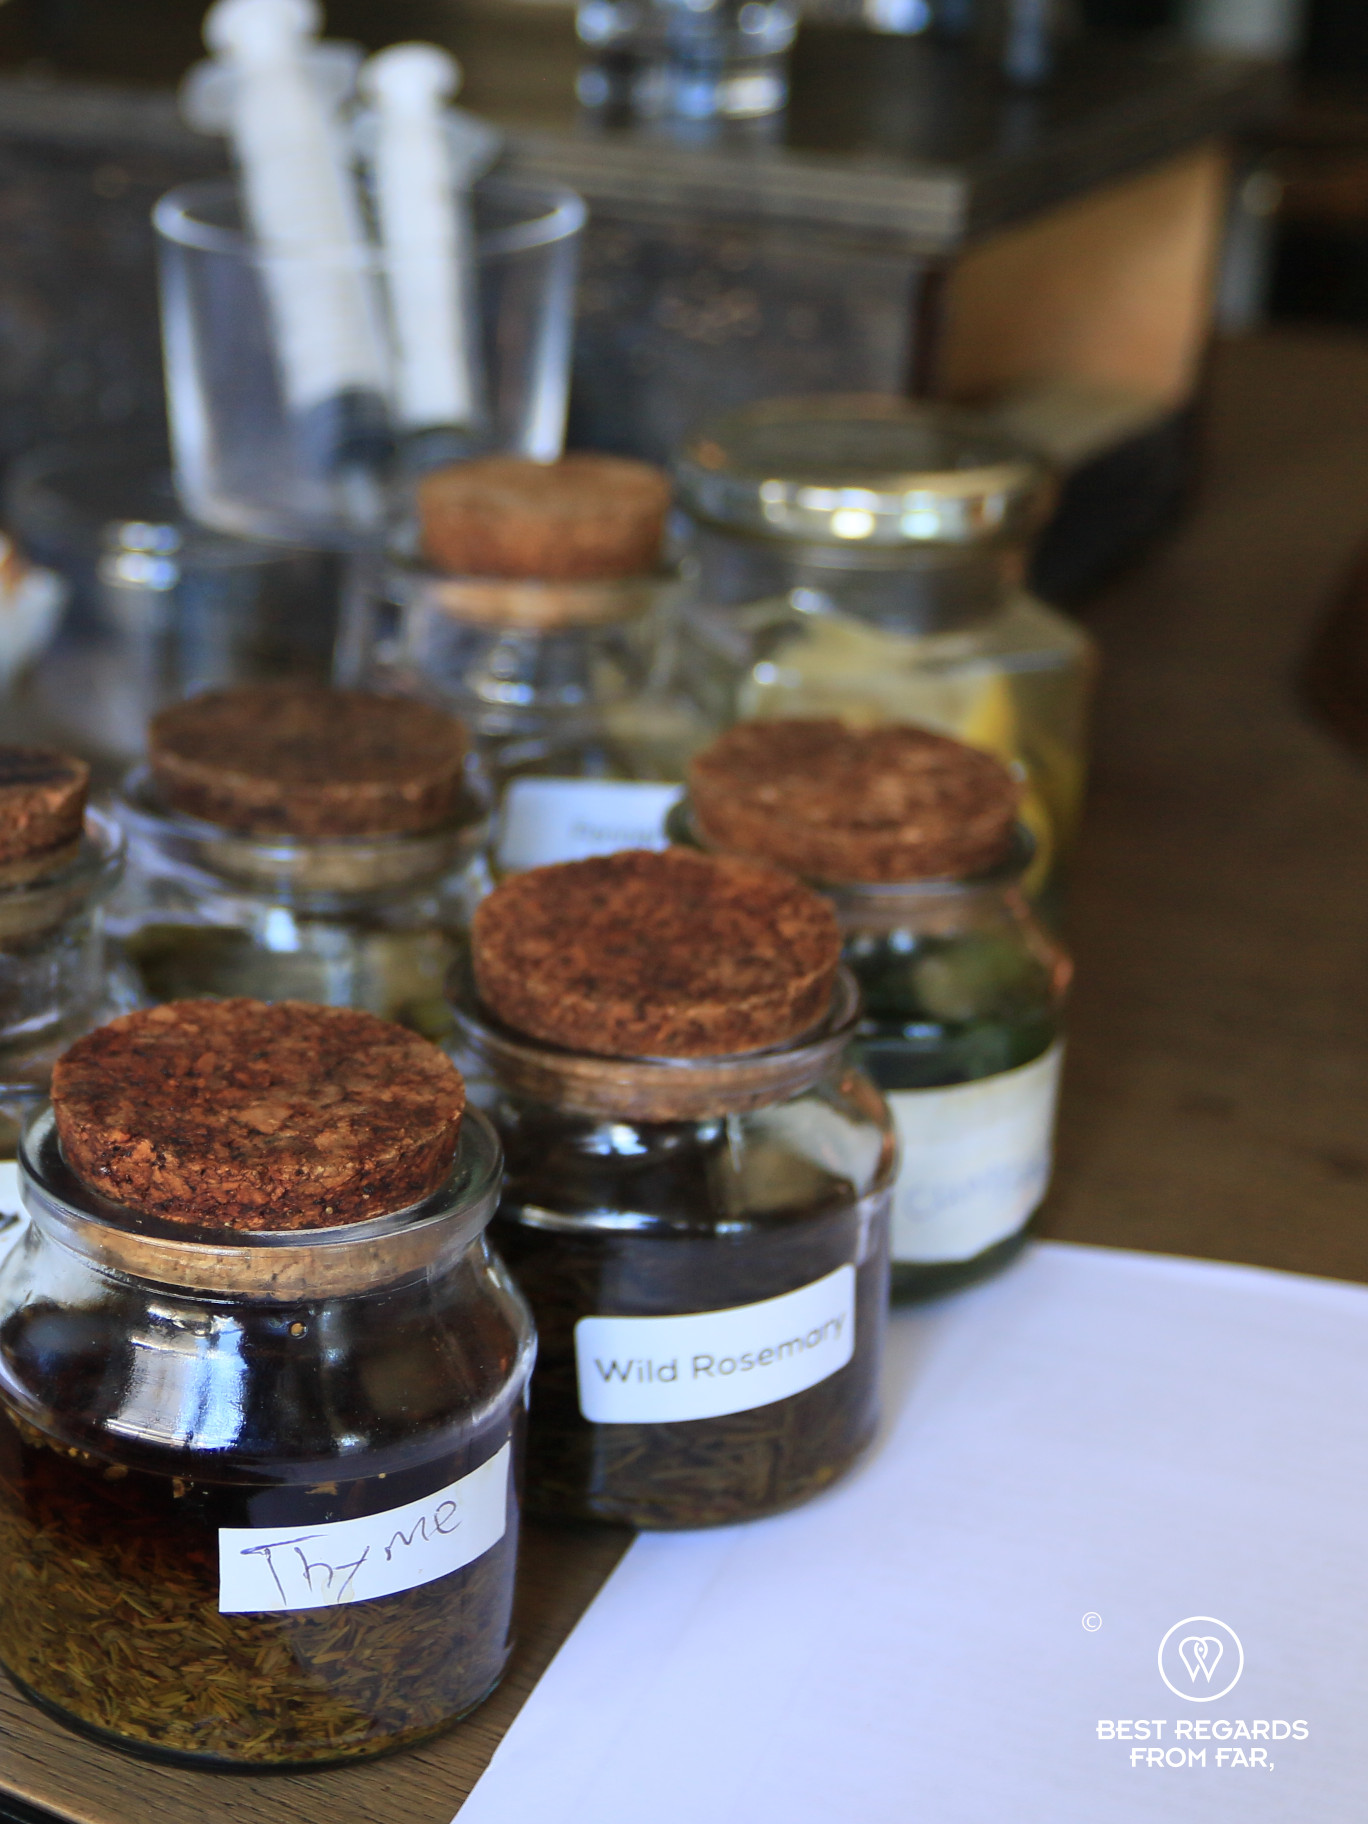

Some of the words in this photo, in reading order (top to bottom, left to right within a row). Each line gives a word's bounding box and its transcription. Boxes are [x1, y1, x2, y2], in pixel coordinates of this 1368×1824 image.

[594, 1357, 679, 1384] Wild
[692, 1311, 847, 1382] Rosemary
[239, 1499, 464, 1607] Thyme
